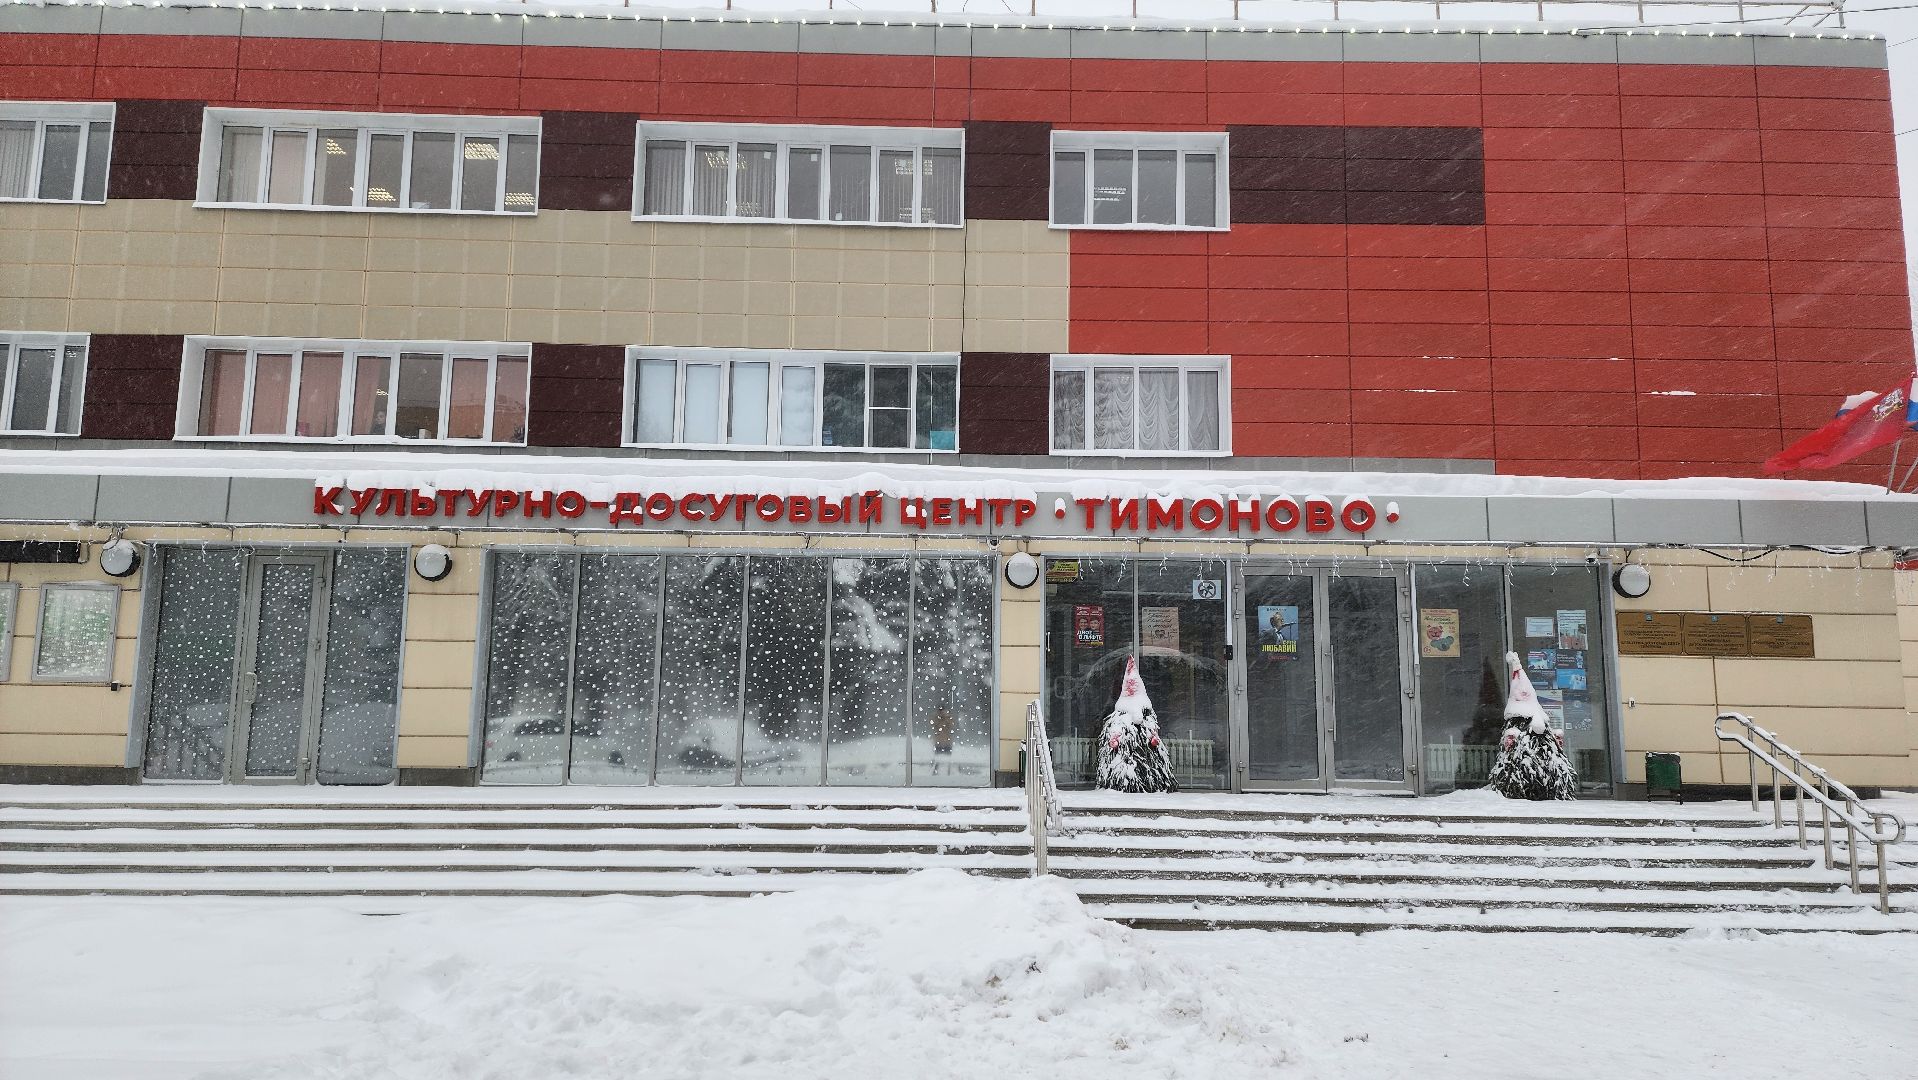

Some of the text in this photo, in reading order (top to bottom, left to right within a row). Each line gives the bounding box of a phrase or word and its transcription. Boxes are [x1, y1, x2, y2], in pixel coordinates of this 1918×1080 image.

[313, 487, 1376, 533] КУЛЬТУРНО-ДОСУГОВЫЙ ЦЕНТР ТИМОНОВО
